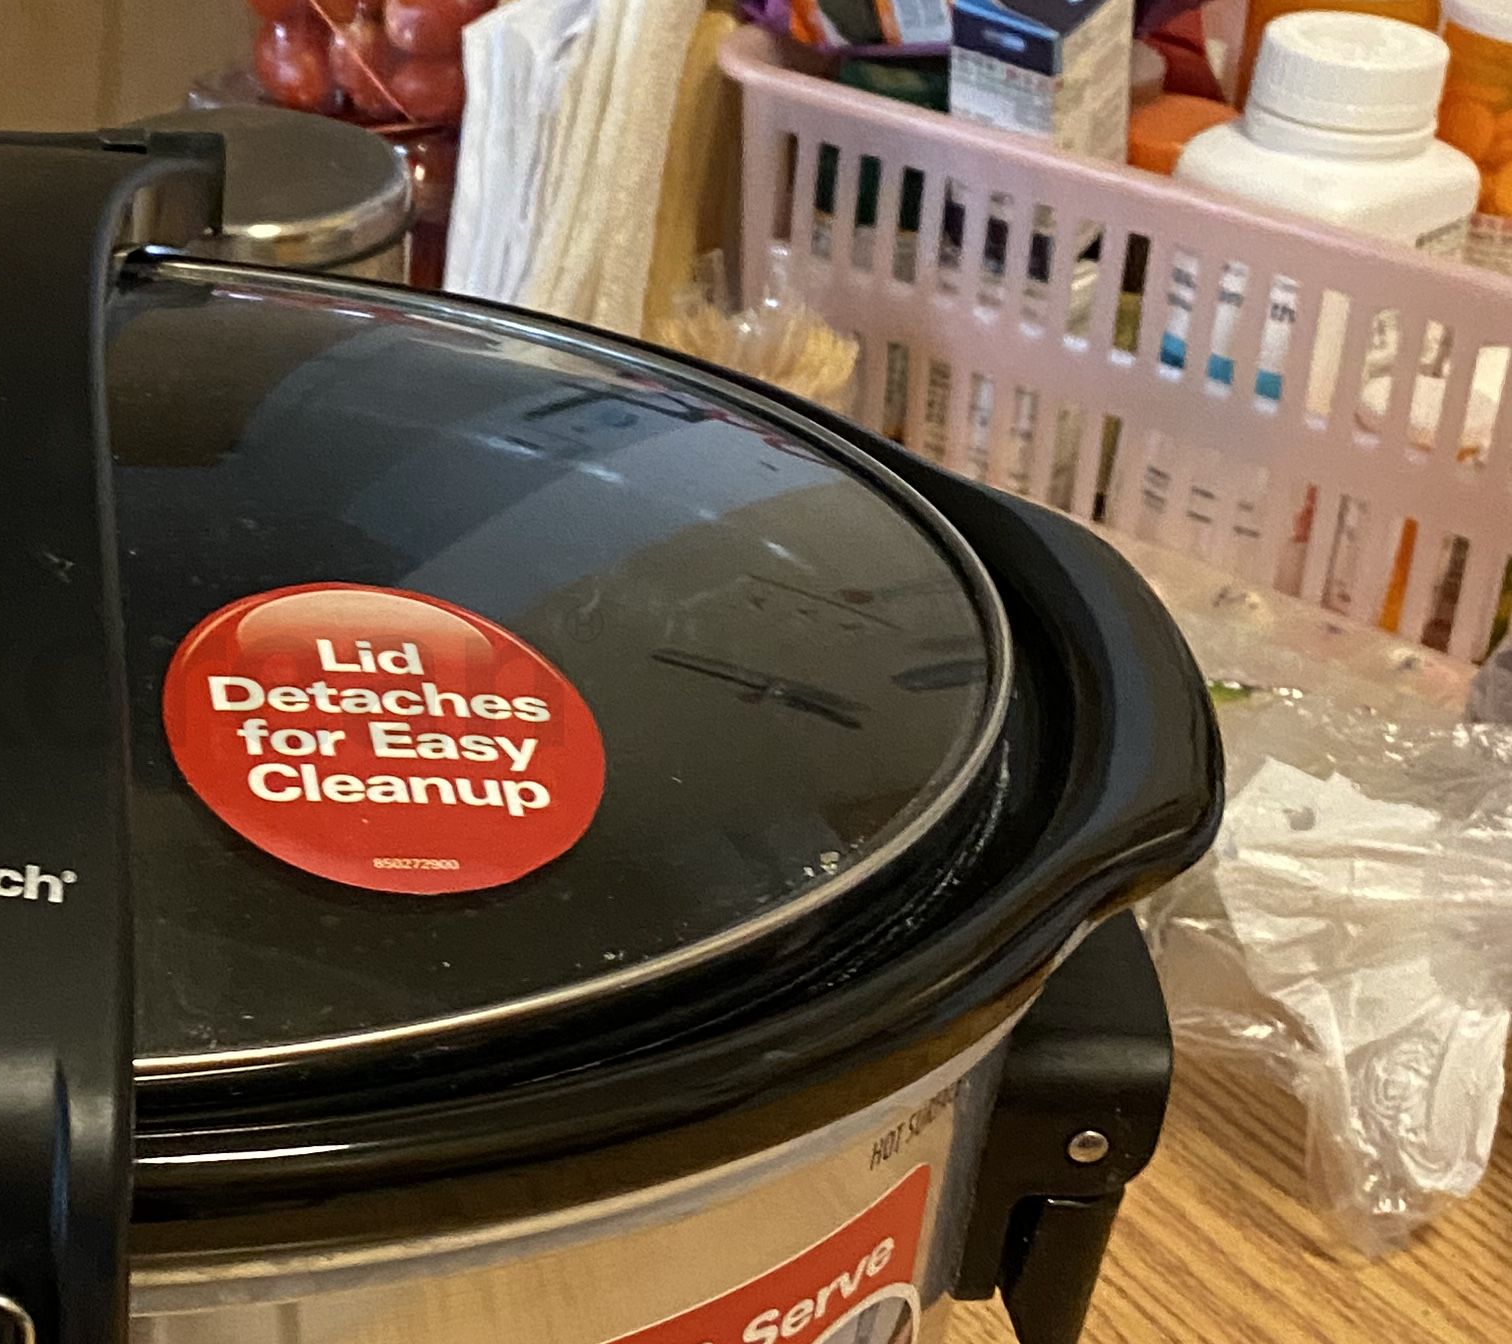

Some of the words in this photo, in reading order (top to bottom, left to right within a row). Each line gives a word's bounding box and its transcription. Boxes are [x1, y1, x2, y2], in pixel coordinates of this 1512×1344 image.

[316, 638, 424, 676] Lid
[207, 675, 551, 723] Detaches
[236, 718, 346, 757] for
[368, 721, 539, 773] Easy
[246, 762, 551, 817] Cleanup
[869, 1121, 906, 1171] HOT
